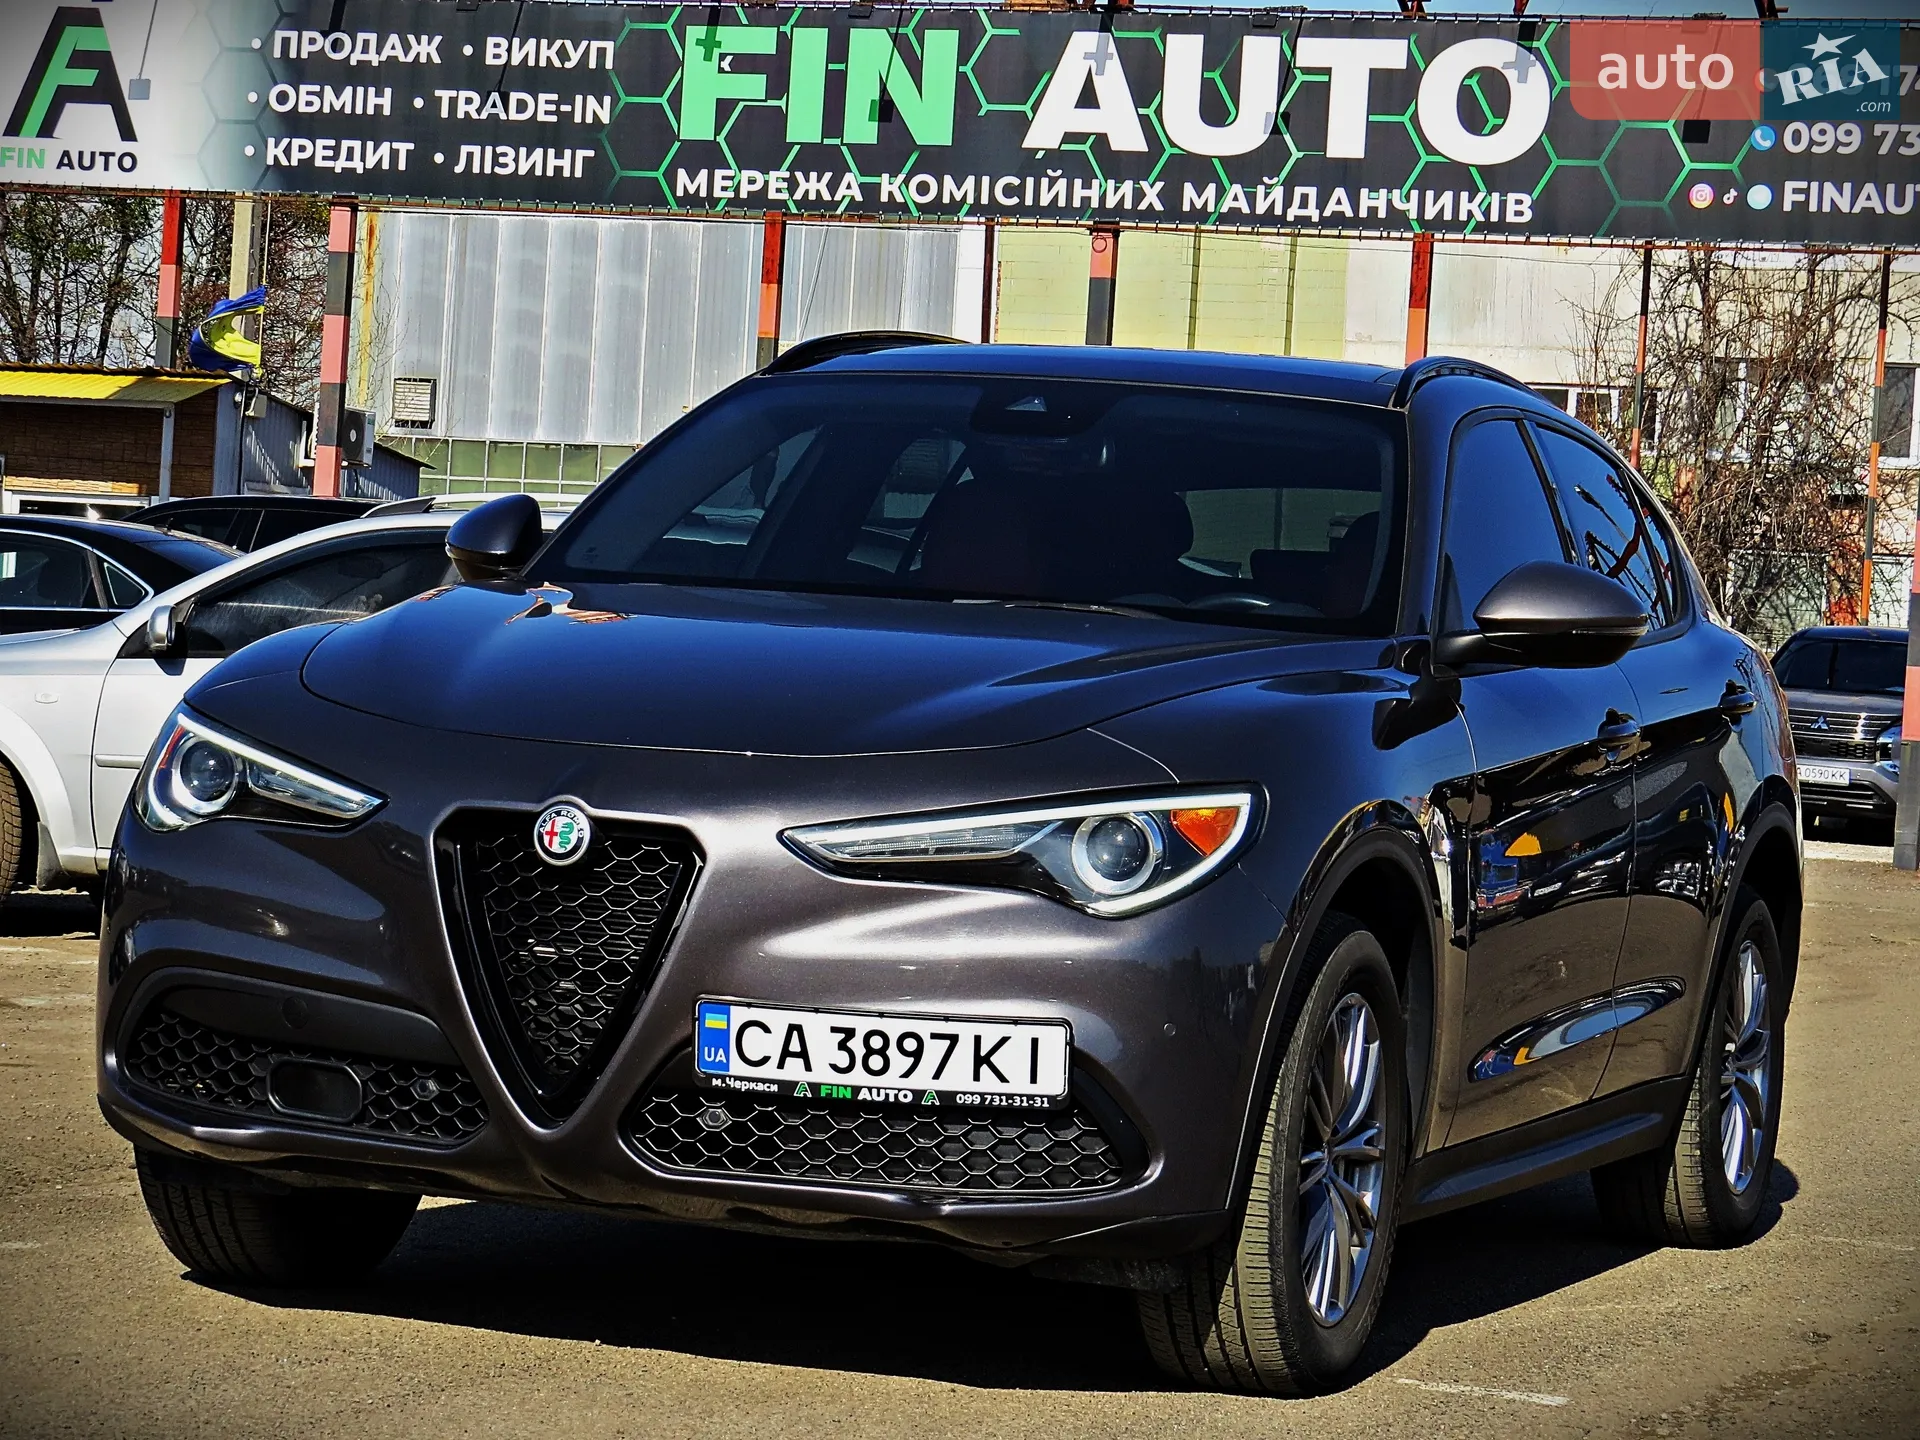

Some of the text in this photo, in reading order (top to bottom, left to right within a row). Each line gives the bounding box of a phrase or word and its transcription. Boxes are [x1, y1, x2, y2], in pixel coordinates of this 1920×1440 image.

[273, 30, 443, 66] ПРОДАЖ
[485, 37, 615, 70] ВИКУП
[269, 84, 392, 116] ОБМІН
[435, 90, 612, 125] TRADE-IN
[679, 25, 1551, 166] FIN AUTO
[1783, 121, 1920, 156] 099 73
[0, 147, 138, 173] FIN AUTO
[266, 138, 415, 174] КРЕДИТ
[454, 144, 596, 179] ЛІЗИНГ
[676, 167, 1533, 223] МЕРЕЖА КОМІСІЙНИХ МАЙДАНЧИКІВ
[1783, 180, 1920, 216] FINAU
[1804, 768, 1830, 780] 0590
[540, 810, 585, 838] ALFA ROMO
[704, 1046, 727, 1064] UA
[735, 1019, 1039, 1085] CA 3897 KI
[712, 1077, 778, 1093] м.Черкаси
[820, 1084, 852, 1099] FIN
[857, 1087, 913, 1103] AUTO
[956, 1093, 1050, 1108] 099 731-31-31
